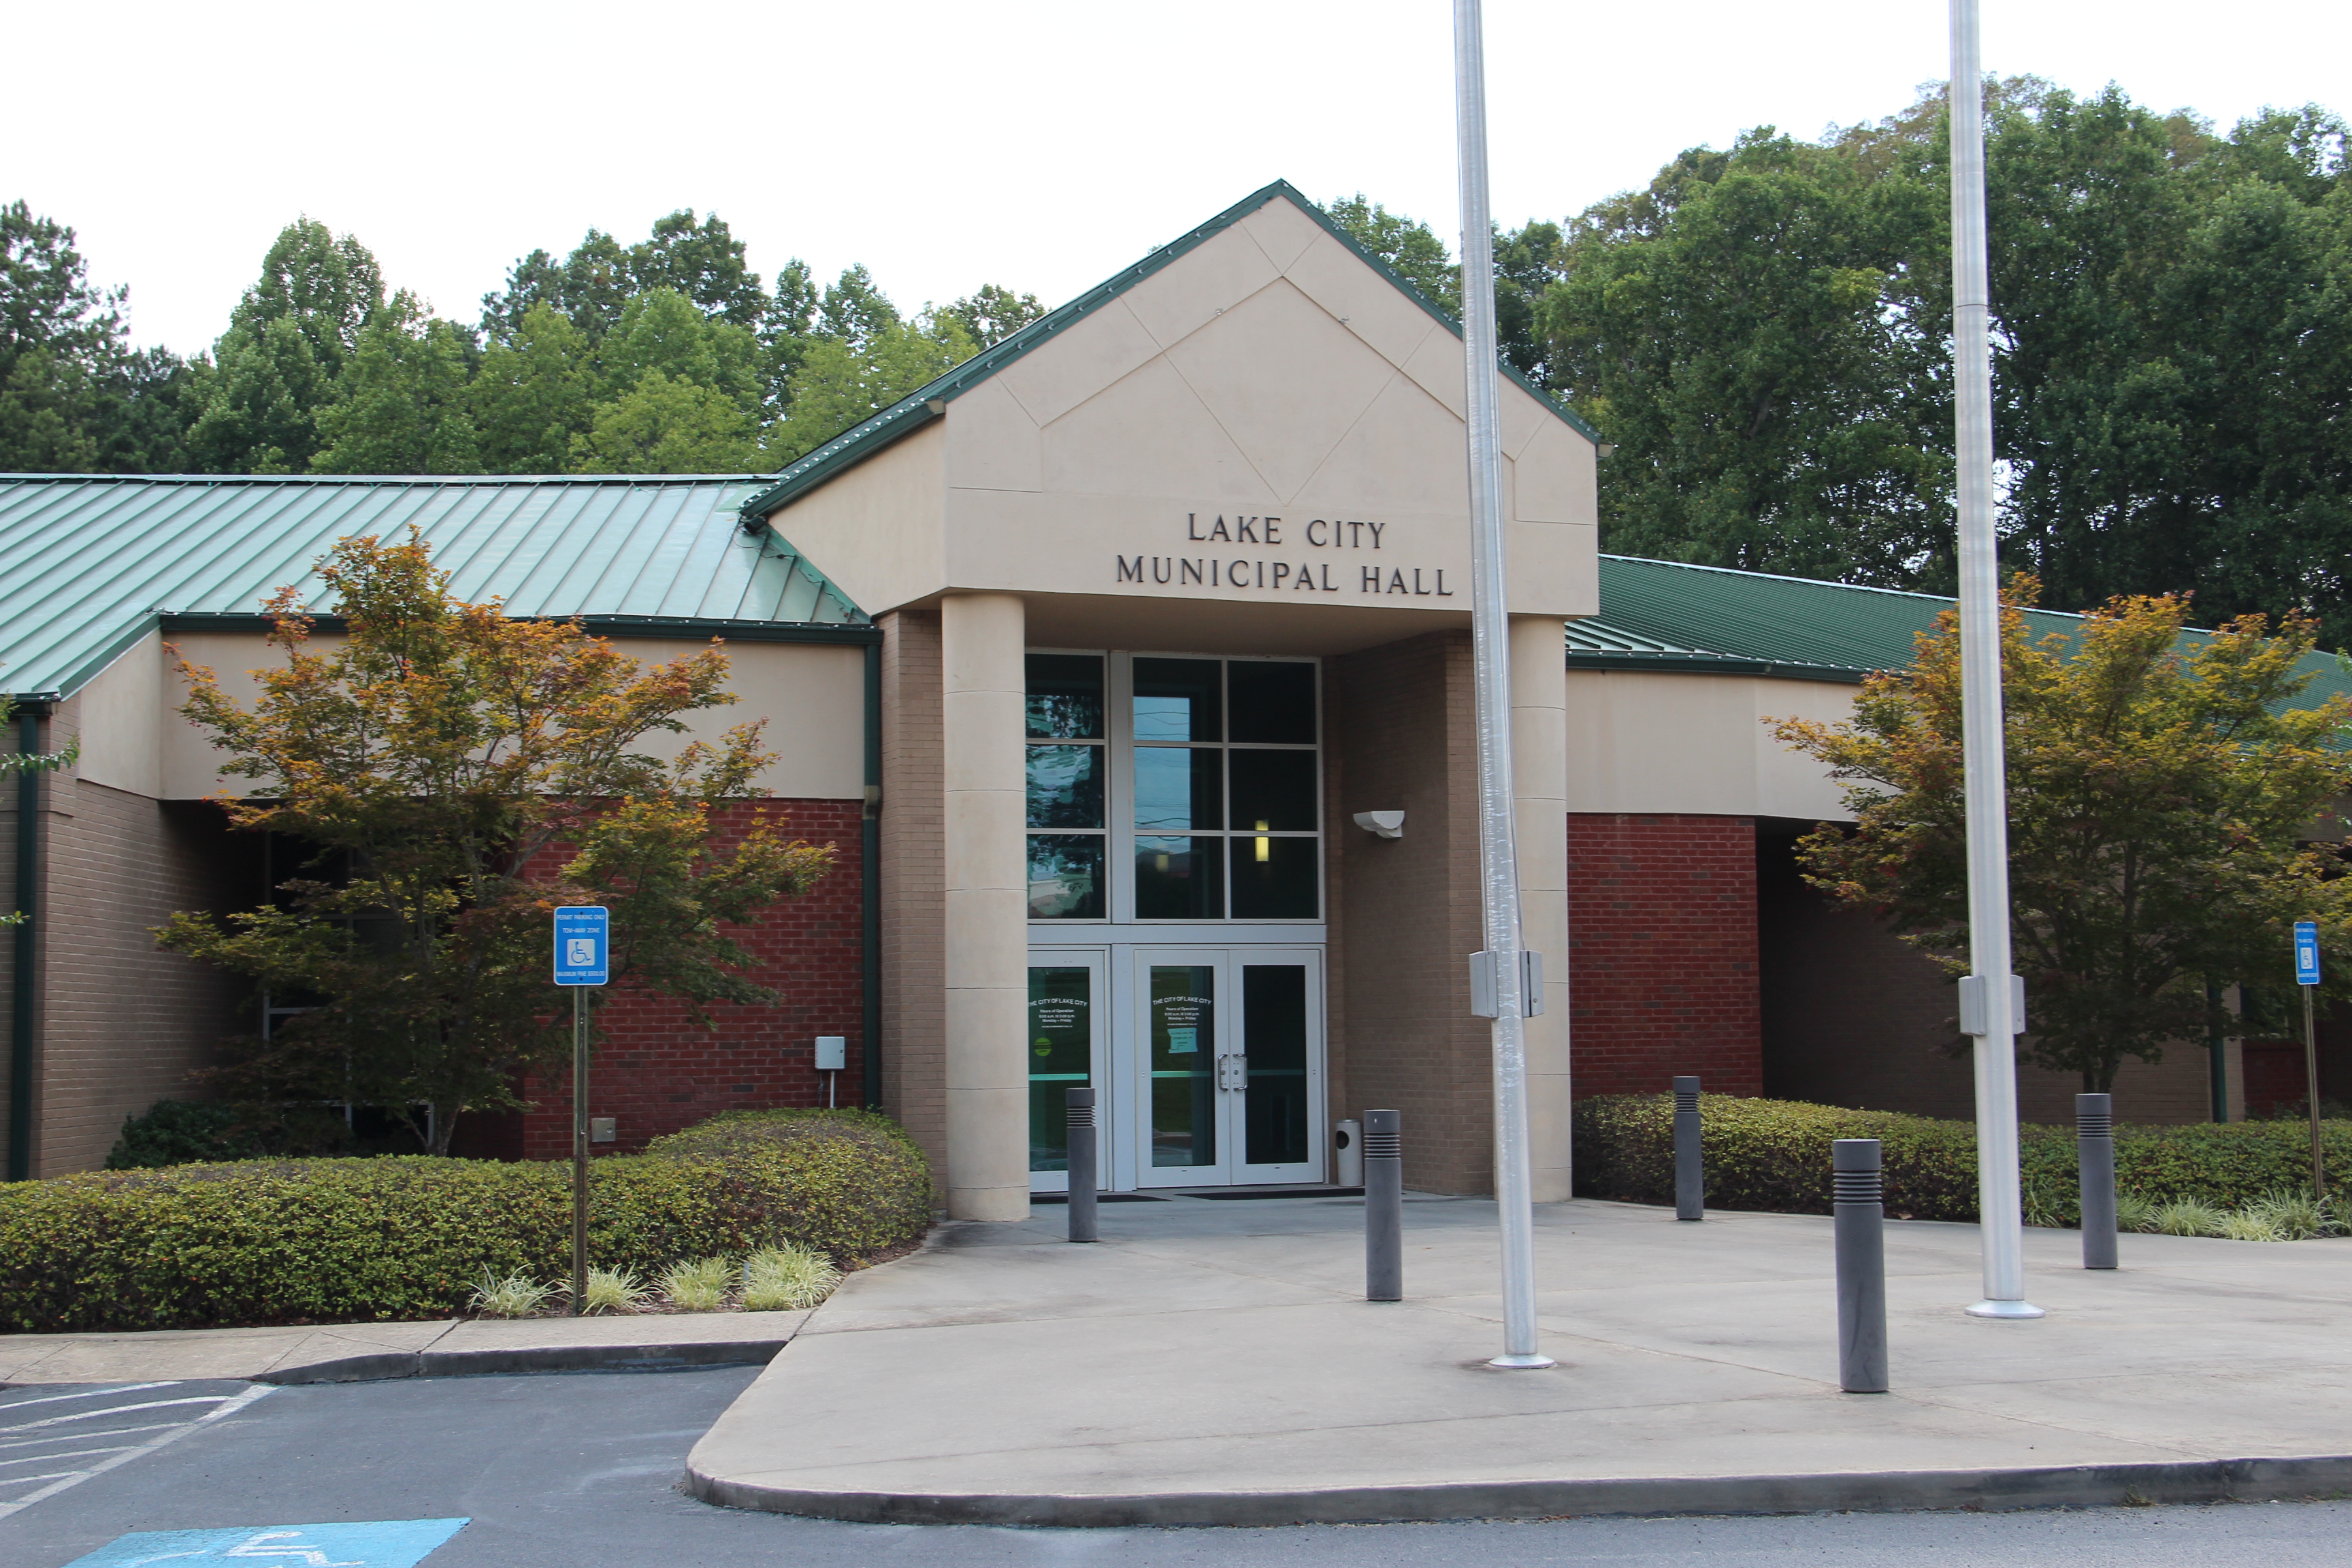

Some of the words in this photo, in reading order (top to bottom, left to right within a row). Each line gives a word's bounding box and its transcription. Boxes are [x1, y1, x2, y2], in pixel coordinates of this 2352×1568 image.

[1188, 513, 1283, 544] LAKE
[1306, 519, 1386, 549] CITY
[1117, 555, 1339, 591] MUNICIPAL
[1361, 566, 1454, 595] HALL
